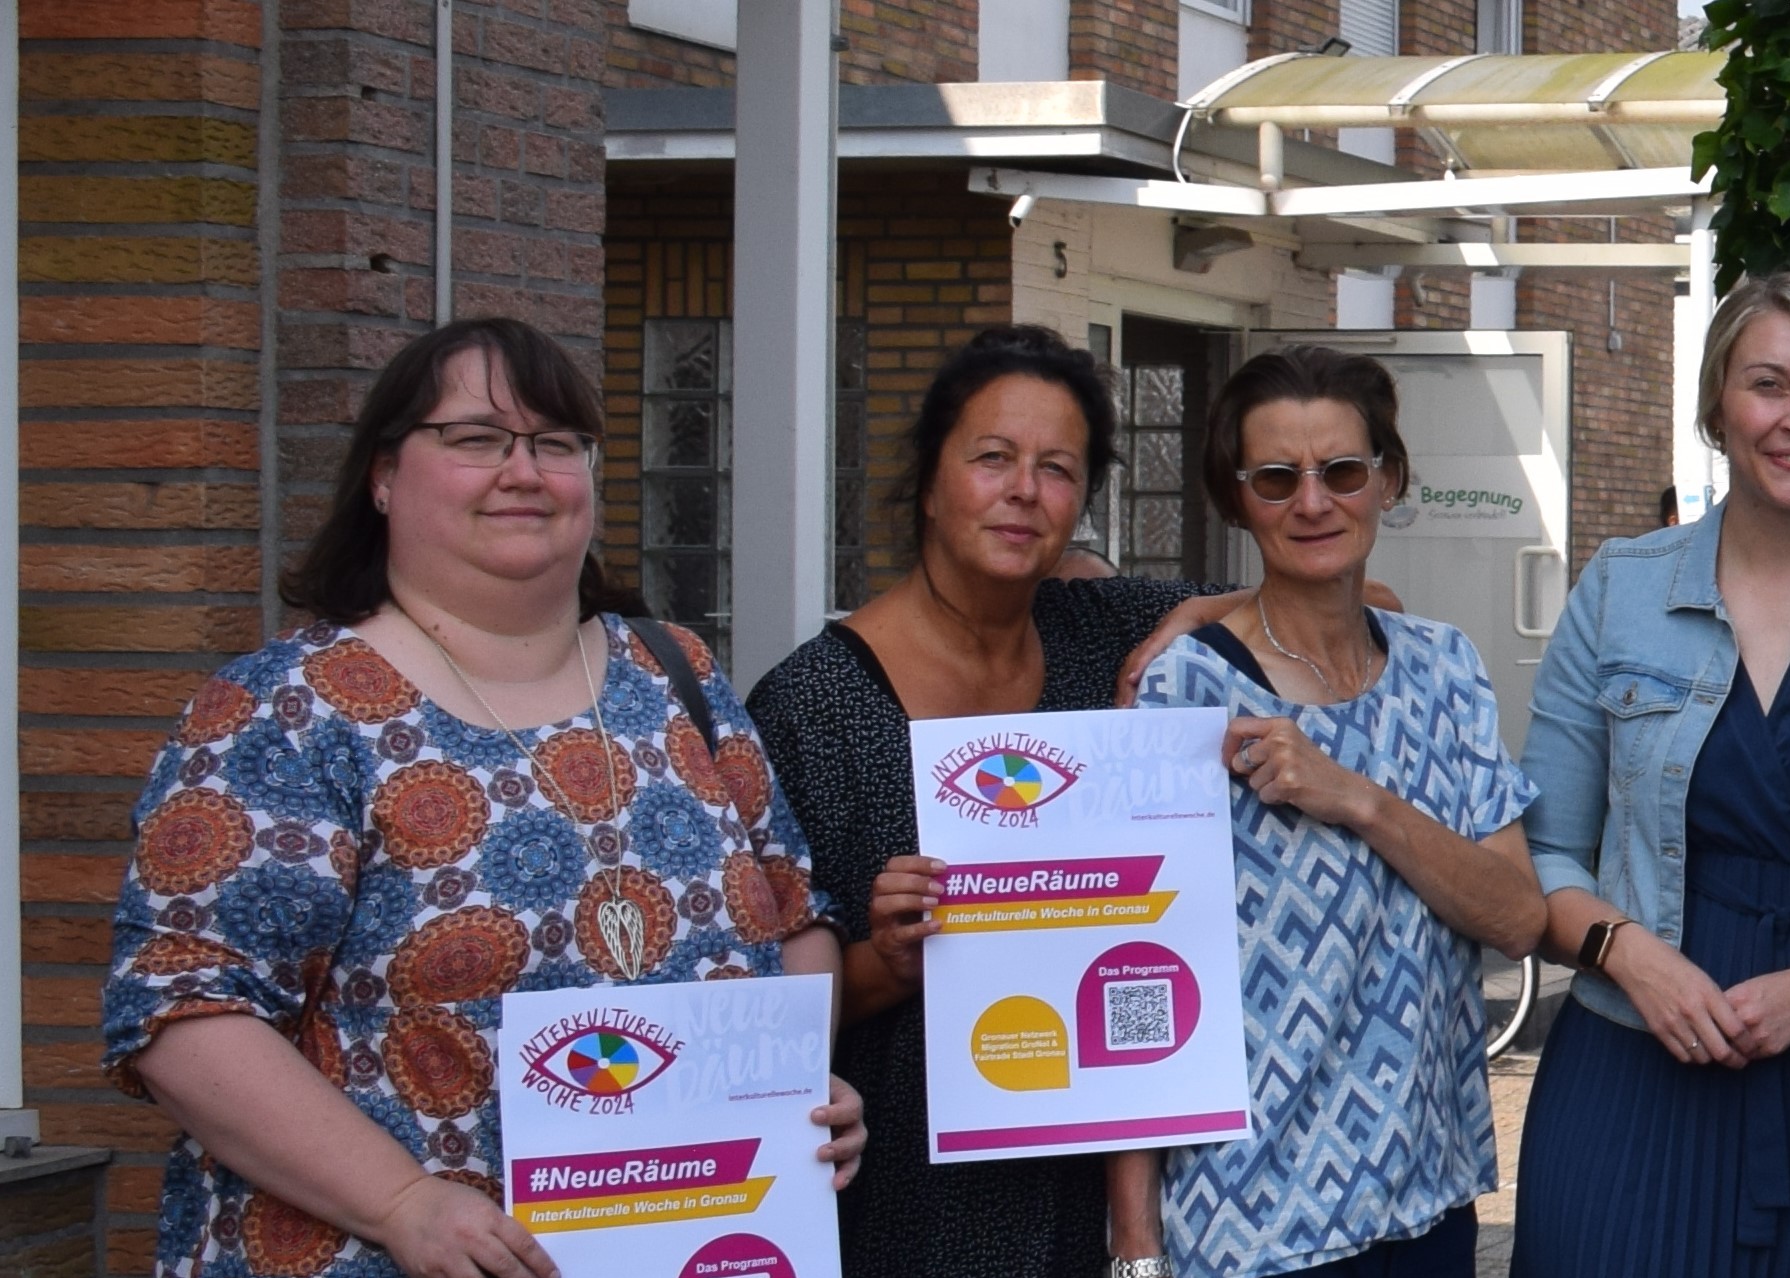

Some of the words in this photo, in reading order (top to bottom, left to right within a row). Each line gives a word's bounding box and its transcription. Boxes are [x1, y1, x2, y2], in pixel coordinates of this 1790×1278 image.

[1054, 241, 1067, 279] 5
[1420, 486, 1523, 514] Begegnung
[930, 732, 1087, 783] INTERKULTURELLE
[935, 786, 990, 825] WOCHE
[998, 808, 1038, 828] 2024
[946, 870, 1119, 895] #NeueRäume
[947, 908, 1037, 923] Interkulturelle
[1040, 907, 1083, 919] Woche
[1087, 905, 1099, 917] in
[1103, 904, 1149, 916] Gronau
[1098, 966, 1119, 977] Das
[1122, 964, 1179, 977] Programm
[519, 1008, 685, 1066] INTERKULTURELLE
[521, 1069, 580, 1112] WOCHE
[589, 1092, 634, 1115] 2024
[530, 1158, 717, 1192] #NeueRäume
[530, 1205, 630, 1223] Interkulturelle
[634, 1199, 680, 1213] Woche
[684, 1196, 696, 1208] in
[700, 1192, 747, 1207] Gronau
[696, 1262, 718, 1274] Das
[721, 1256, 777, 1272] Programm
